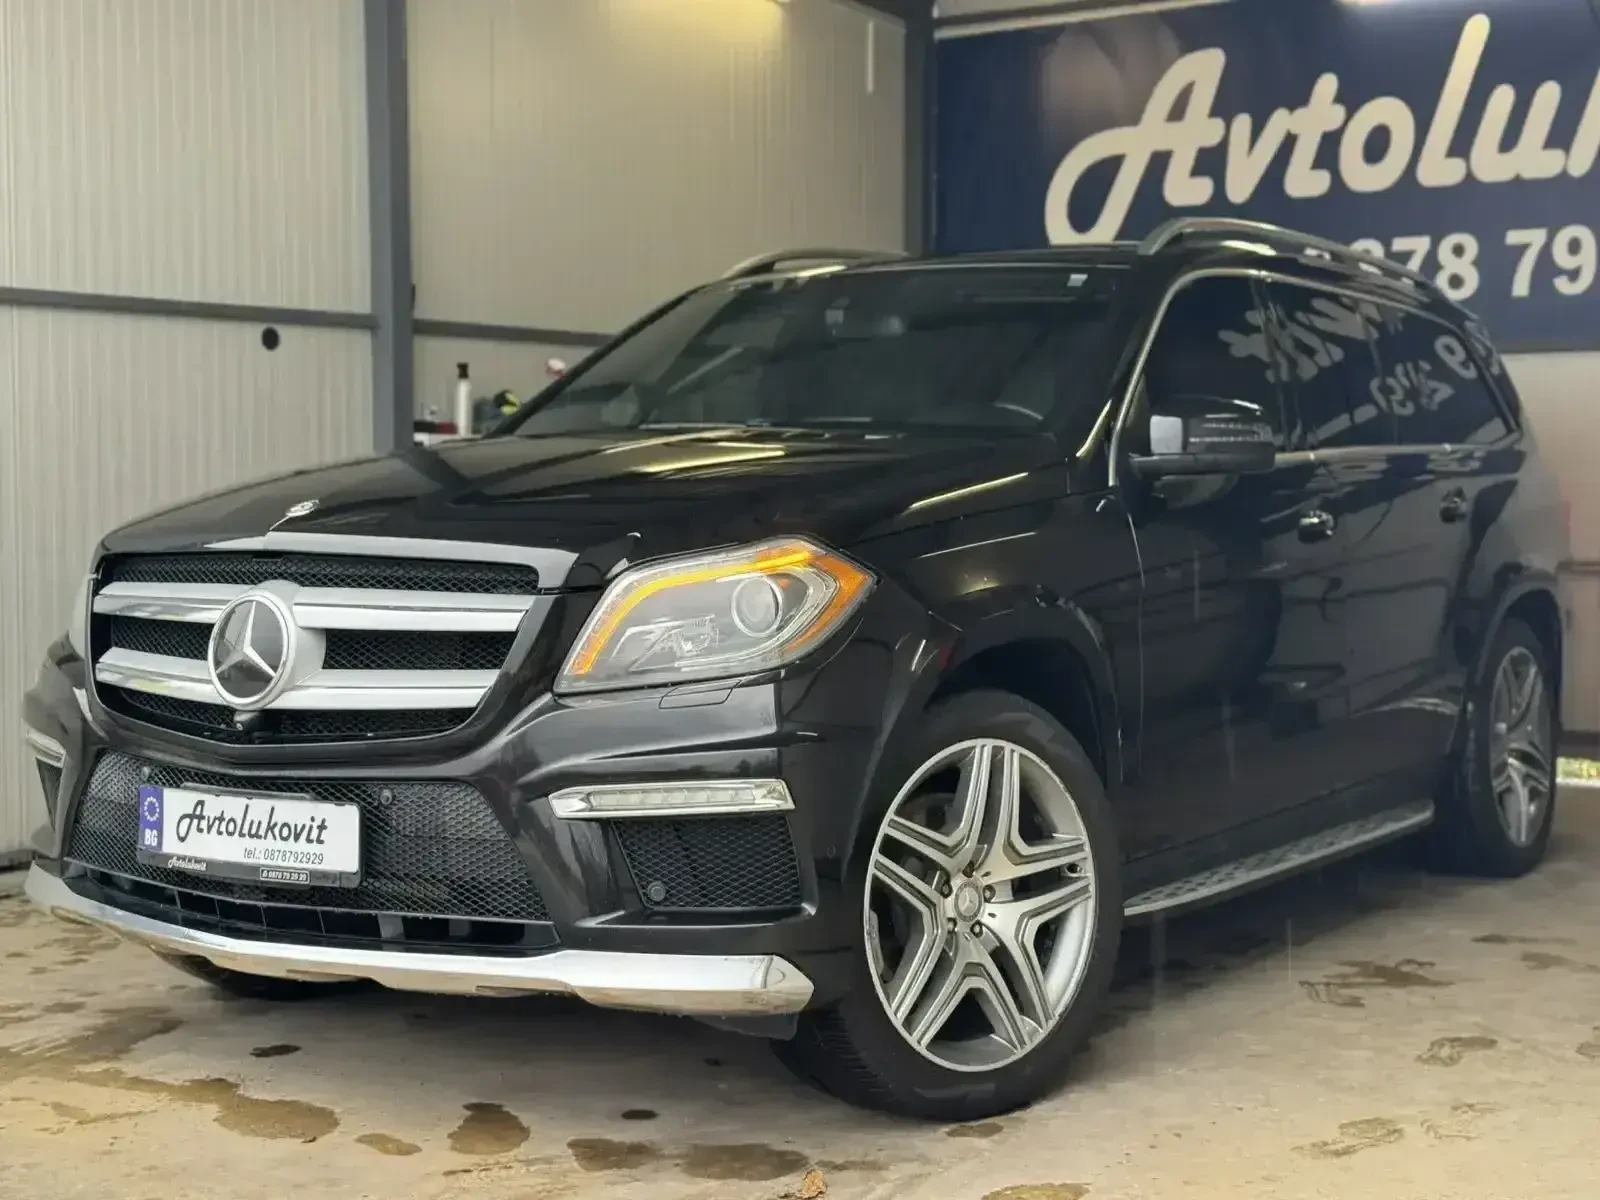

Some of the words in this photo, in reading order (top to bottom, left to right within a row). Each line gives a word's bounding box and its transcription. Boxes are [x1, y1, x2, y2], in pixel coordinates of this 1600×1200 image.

[1505, 224, 1597, 296] 79
[144, 828, 158, 847] BG
[176, 800, 328, 845] Avtolukovit
[167, 856, 207, 871] Avtolukovit
